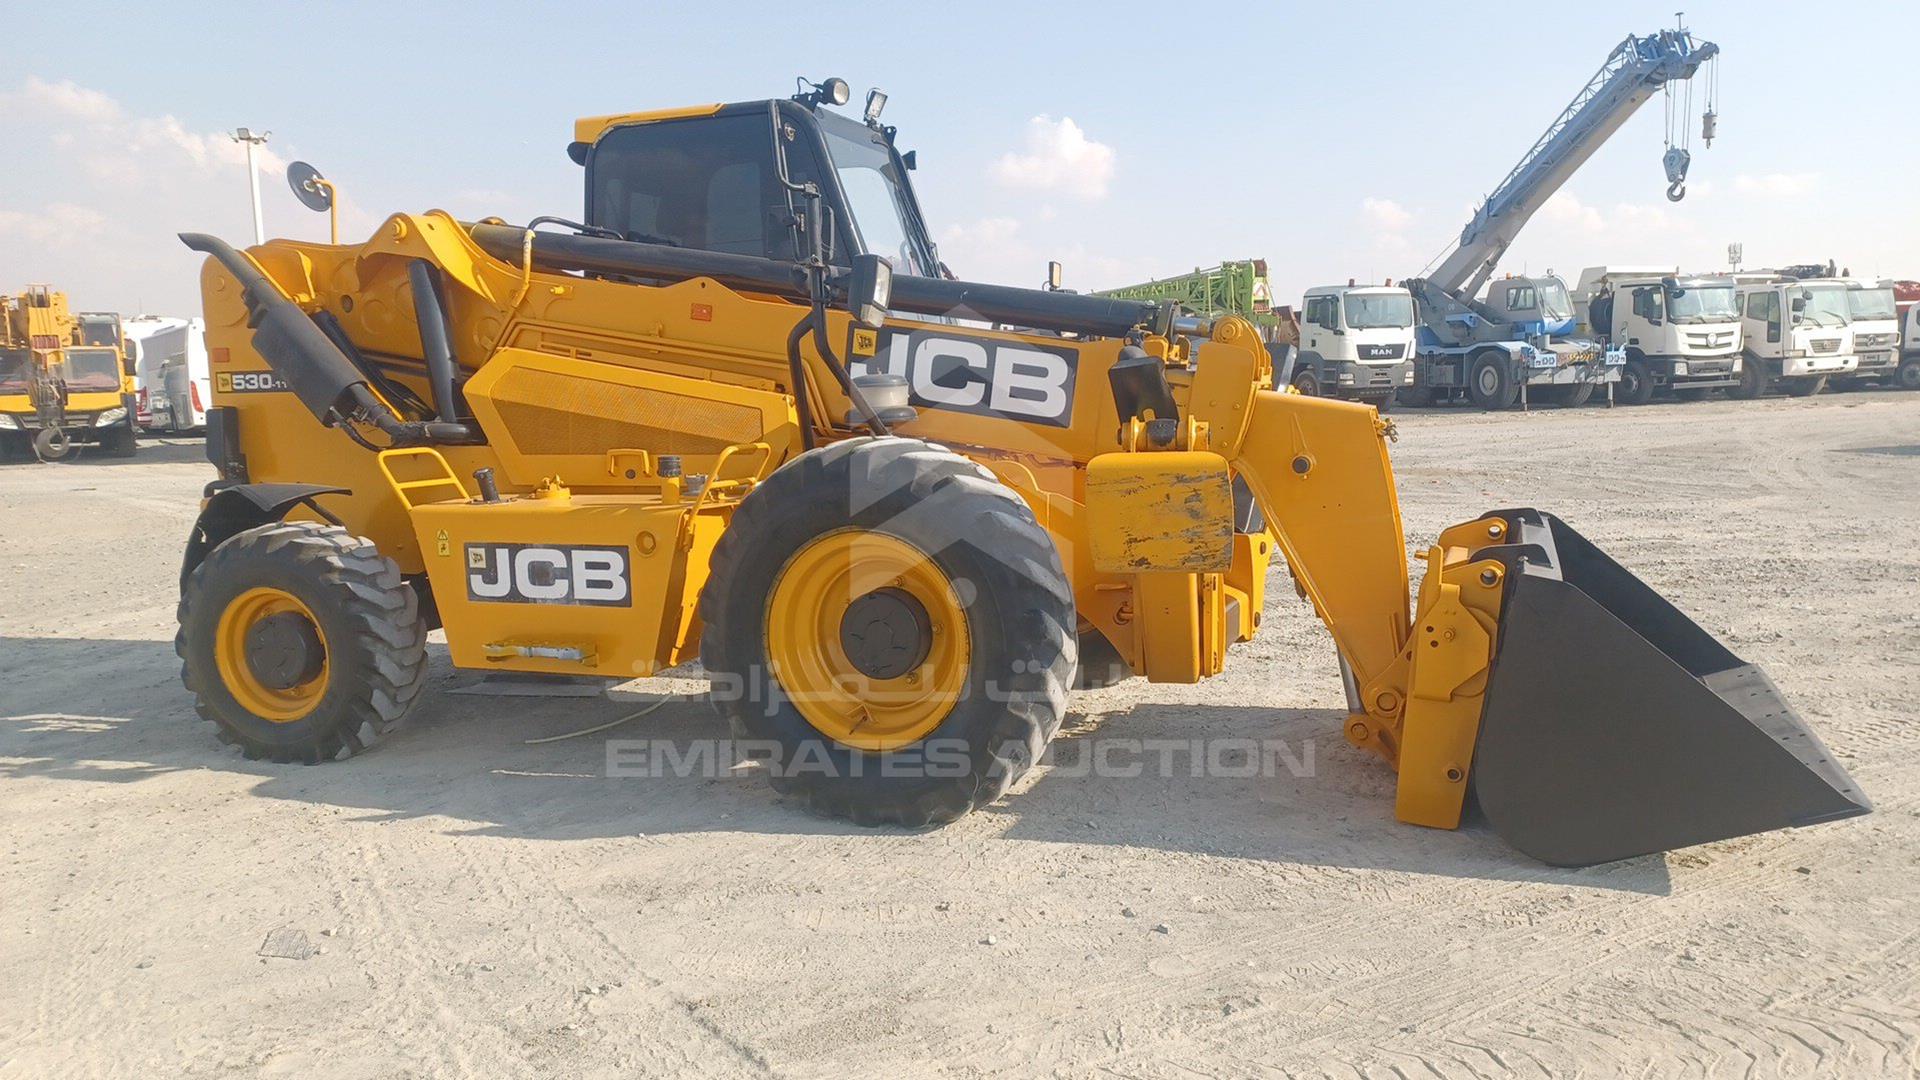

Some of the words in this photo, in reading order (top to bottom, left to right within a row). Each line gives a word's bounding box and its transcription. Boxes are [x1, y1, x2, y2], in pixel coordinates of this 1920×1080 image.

[850, 333, 1068, 418] JCB
[1371, 348, 1393, 356] MAN
[470, 547, 627, 601] JCB
